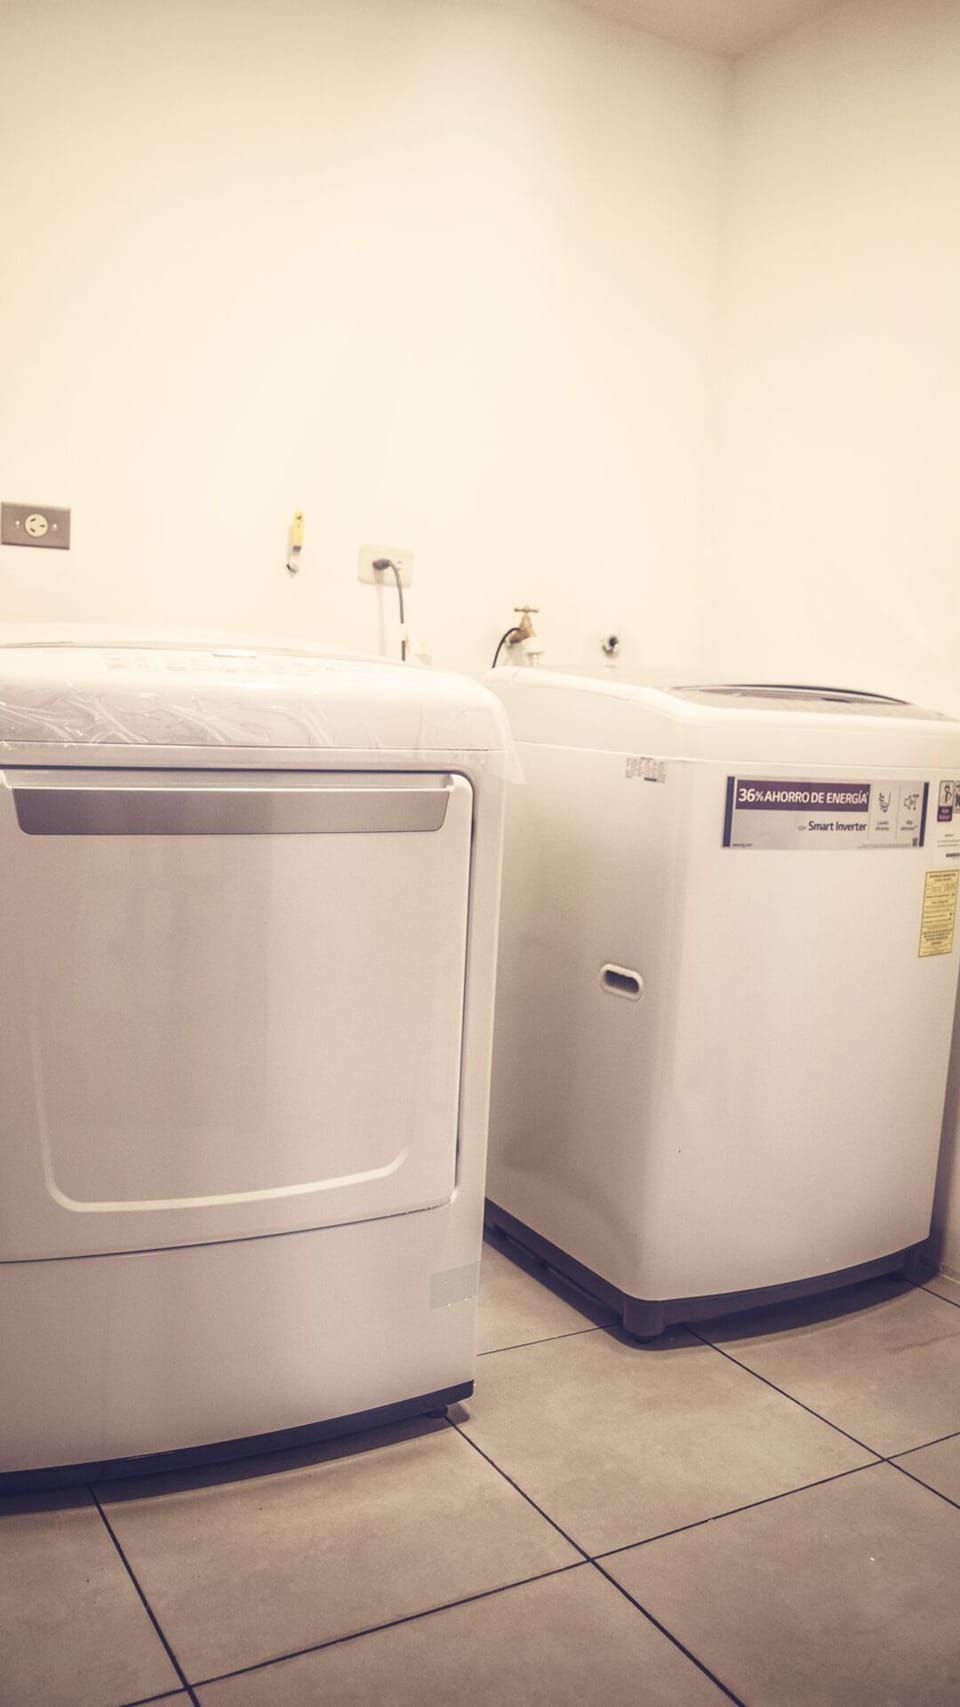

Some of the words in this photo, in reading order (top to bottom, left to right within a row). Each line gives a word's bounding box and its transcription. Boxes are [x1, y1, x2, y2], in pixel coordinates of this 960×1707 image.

[738, 788, 764, 803] 36%
[765, 791, 810, 804] AHORRO
[811, 791, 825, 804] DE
[808, 820, 834, 831] Smart
[835, 821, 867, 831] Inverter
